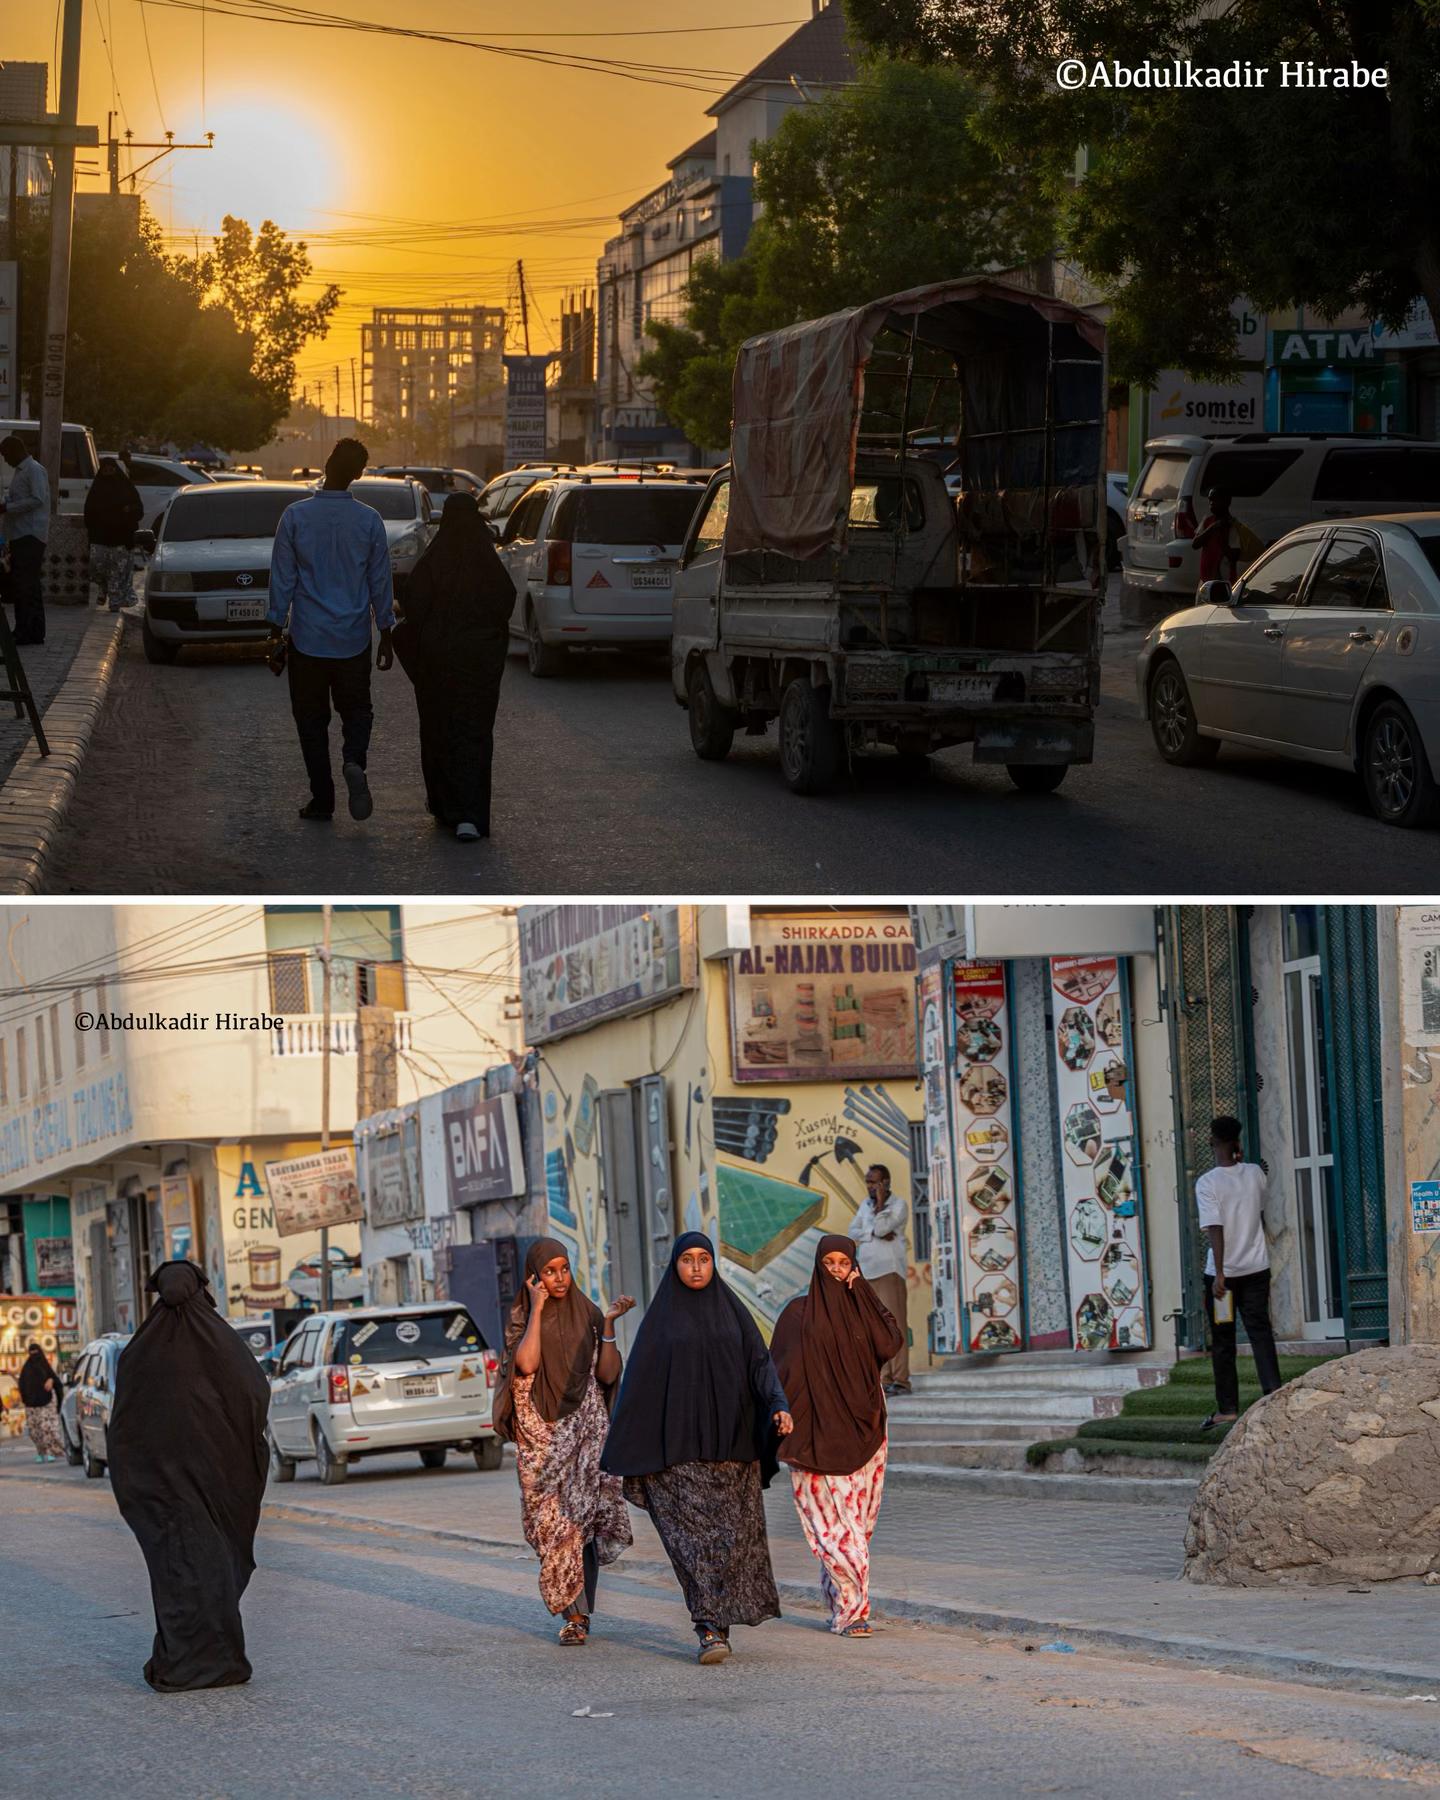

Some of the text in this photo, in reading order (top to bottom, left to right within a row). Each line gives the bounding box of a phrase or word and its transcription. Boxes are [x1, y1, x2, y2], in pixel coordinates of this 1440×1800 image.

[1280, 333, 1375, 360] ATM
[1185, 398, 1255, 419] somtel
[782, 925, 913, 939] SHIRKADDA QA
[739, 943, 917, 974] AL-NAJAX BUILD
